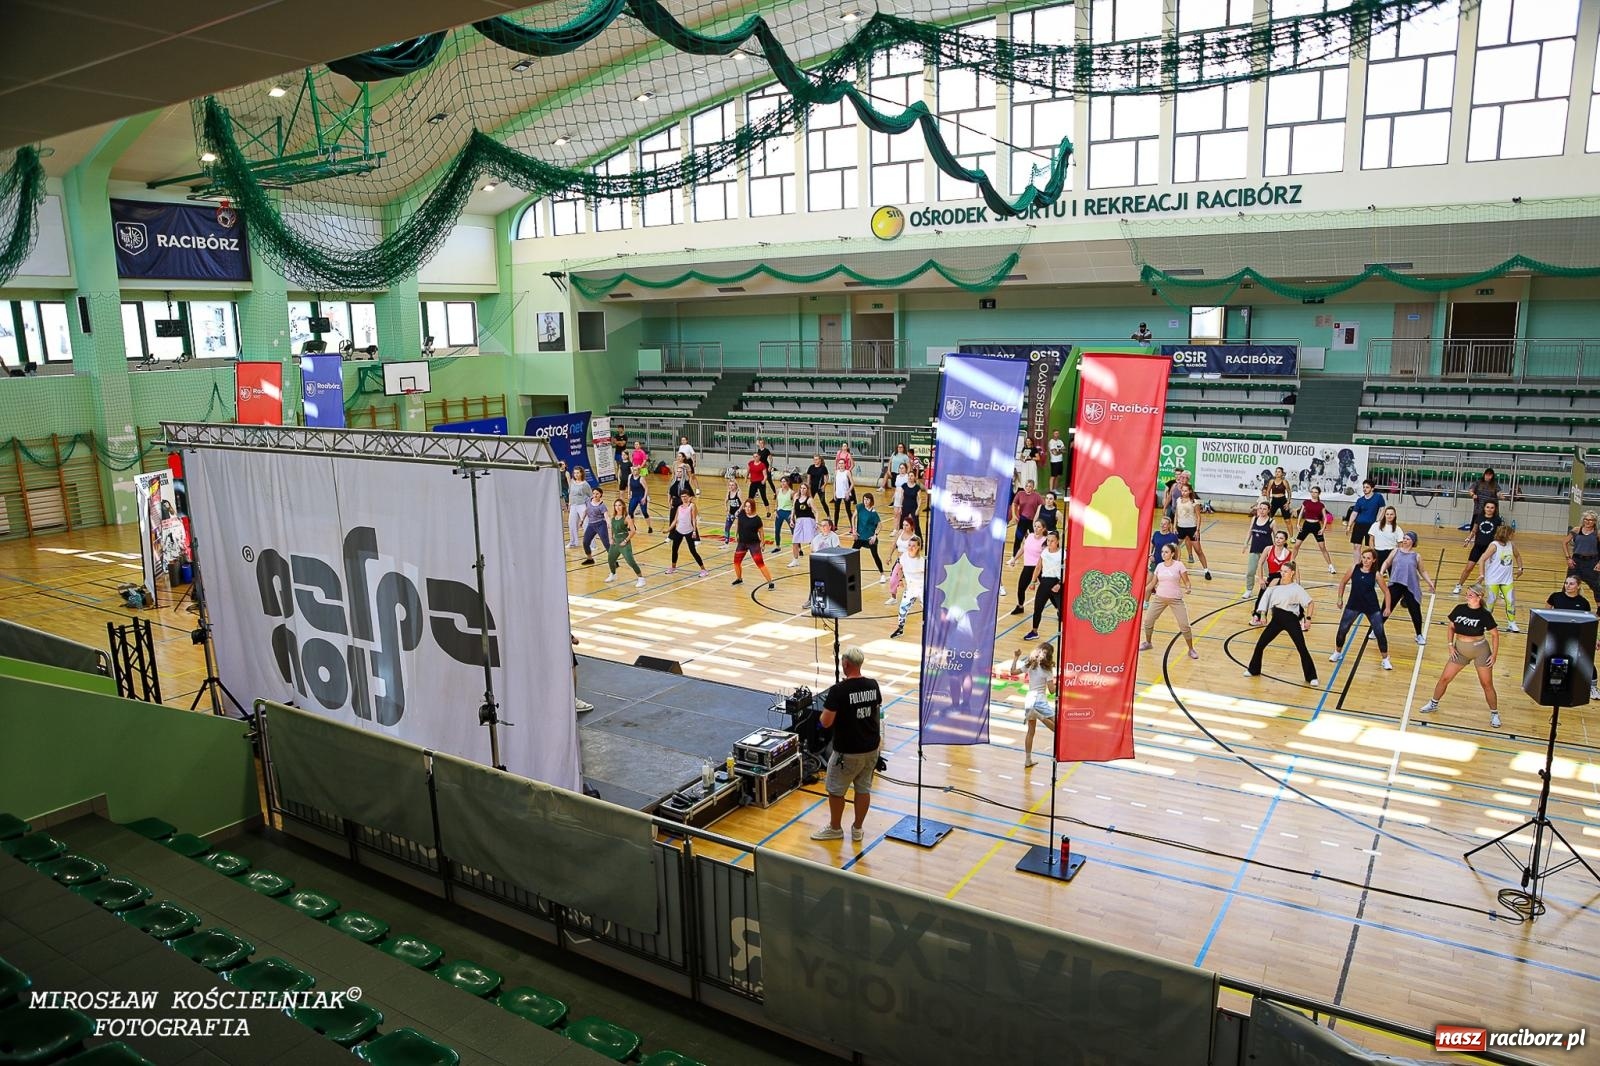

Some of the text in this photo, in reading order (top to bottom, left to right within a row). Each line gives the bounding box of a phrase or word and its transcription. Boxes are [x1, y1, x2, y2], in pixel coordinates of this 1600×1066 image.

[910, 206, 988, 227] OŚRODEK
[1084, 192, 1188, 216] REKREACJI
[1196, 182, 1303, 210] RACIBÓRZ
[156, 233, 240, 251] RACIBÓRZ
[1225, 352, 1284, 365] RACIBÓRZ
[969, 400, 1017, 413] Racibórz
[1109, 402, 1159, 414] Racibórz
[1202, 441, 1315, 456] WSZYSTKO DLA TWOJEGO
[1202, 452, 1279, 466] DOMOWEGO ZOO
[1454, 615, 1480, 627] SPORT
[1066, 661, 1125, 675] Dodaj coś
[849, 689, 877, 704] FULLMOON
